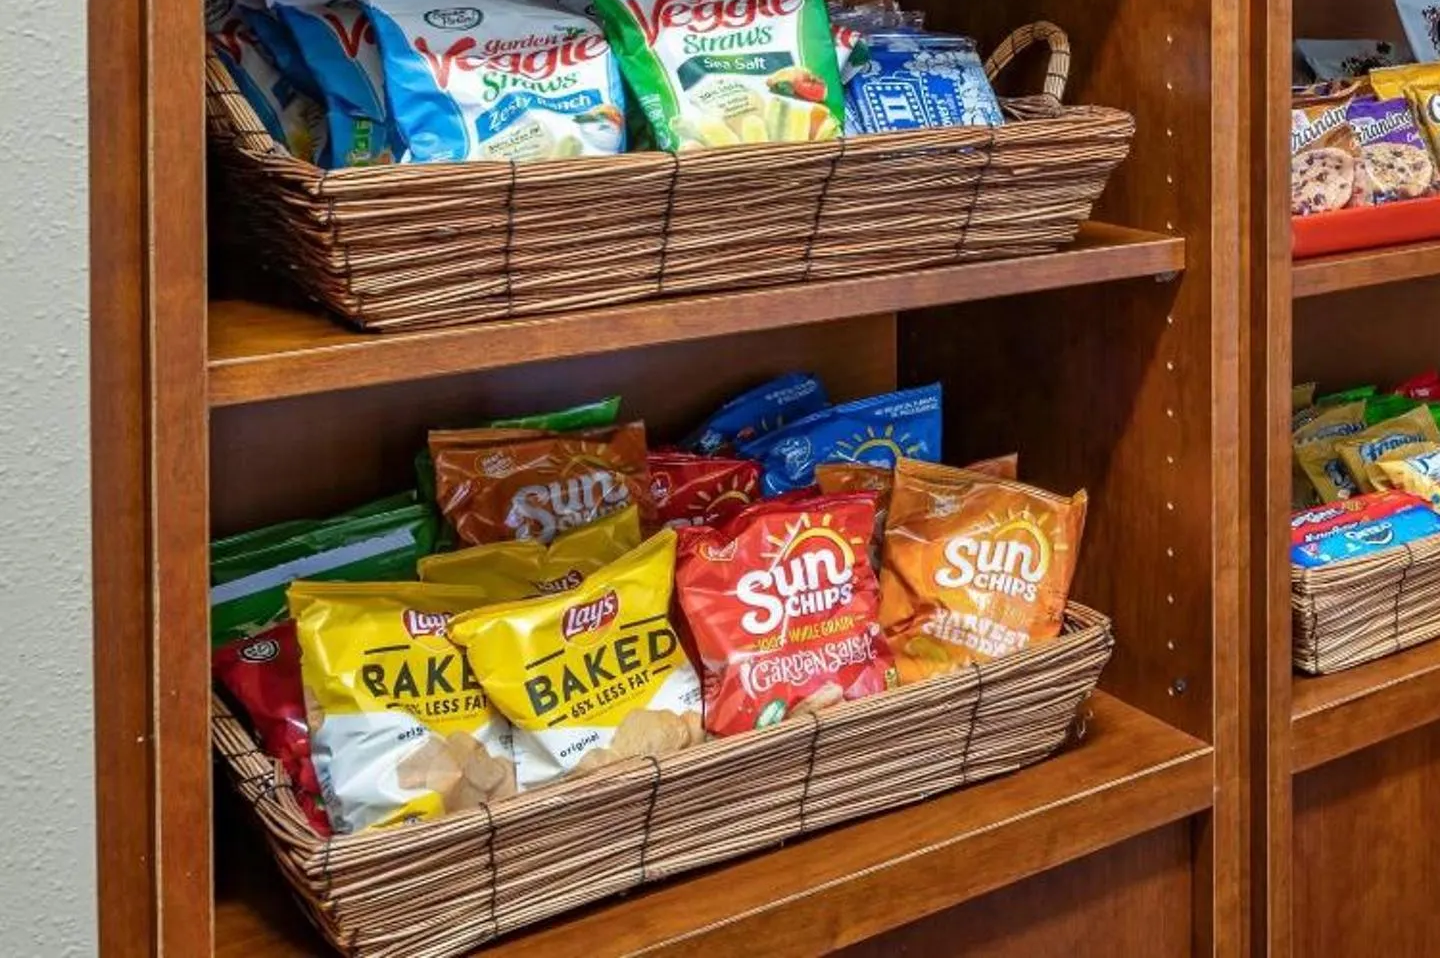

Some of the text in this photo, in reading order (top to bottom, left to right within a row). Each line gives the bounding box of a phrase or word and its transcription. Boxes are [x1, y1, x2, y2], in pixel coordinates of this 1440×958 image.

[484, 34, 552, 54] Garden
[683, 24, 773, 56] Straws
[414, 31, 609, 90] Veggie
[703, 55, 766, 70] Sea Salt
[482, 70, 578, 103] Straws
[488, 94, 532, 130] Zesty
[506, 469, 630, 545] Sun
[935, 536, 1044, 589] Sun
[737, 546, 851, 634] Sun
[785, 583, 854, 619] CHIPS
[973, 574, 1039, 603] CHIPS
[566, 592, 616, 634] Lay's
[362, 653, 480, 698] BAKE
[524, 629, 678, 717] BAKED
[426, 698, 460, 716] LESS
[570, 670, 651, 717] 65% LESS FAT
[560, 731, 601, 758] original
